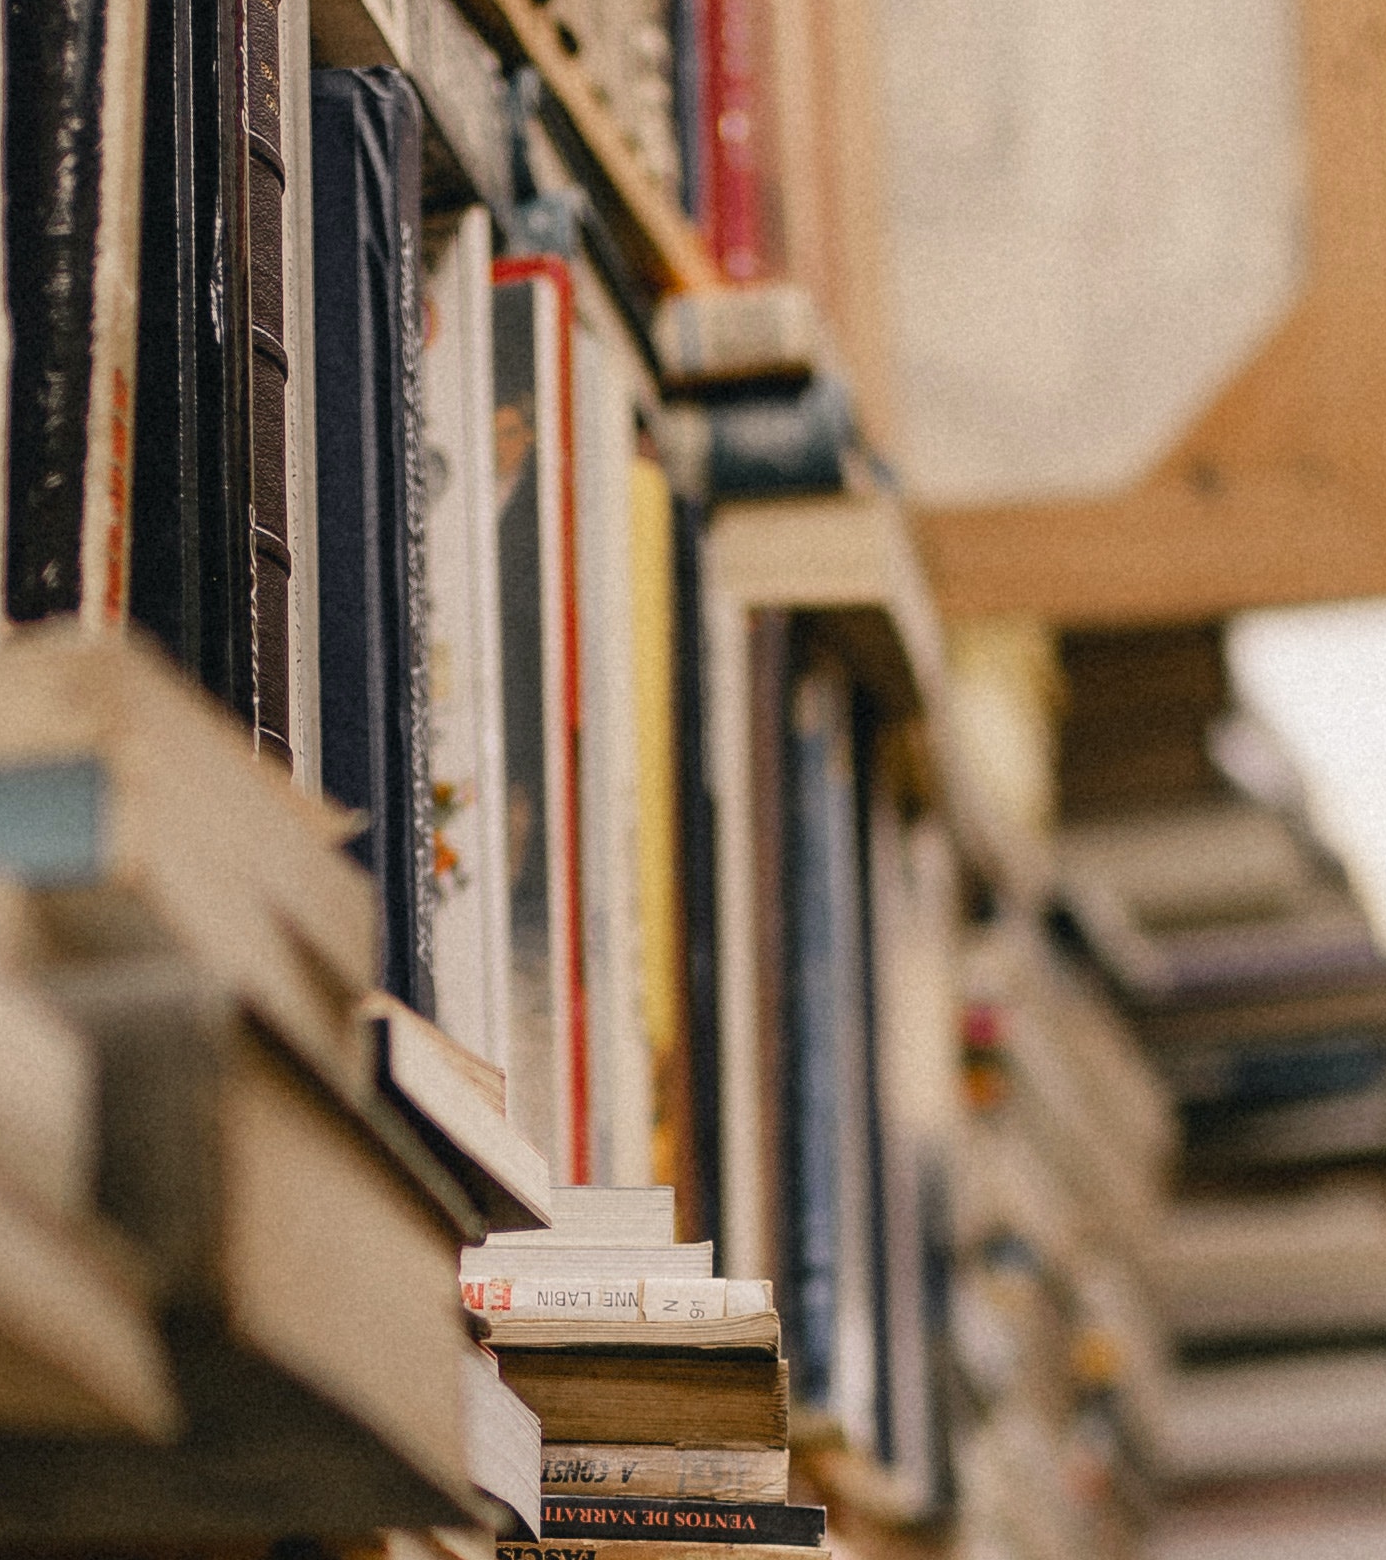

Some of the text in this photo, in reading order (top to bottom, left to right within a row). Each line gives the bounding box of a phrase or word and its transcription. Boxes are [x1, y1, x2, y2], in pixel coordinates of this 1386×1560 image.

[537, 1290, 592, 1308] LABIN
[662, 1299, 679, 1313] N
[689, 1299, 707, 1320] 91
[621, 1461, 639, 1484] A
[540, 1505, 757, 1530] VENTOS DE NARRATI
